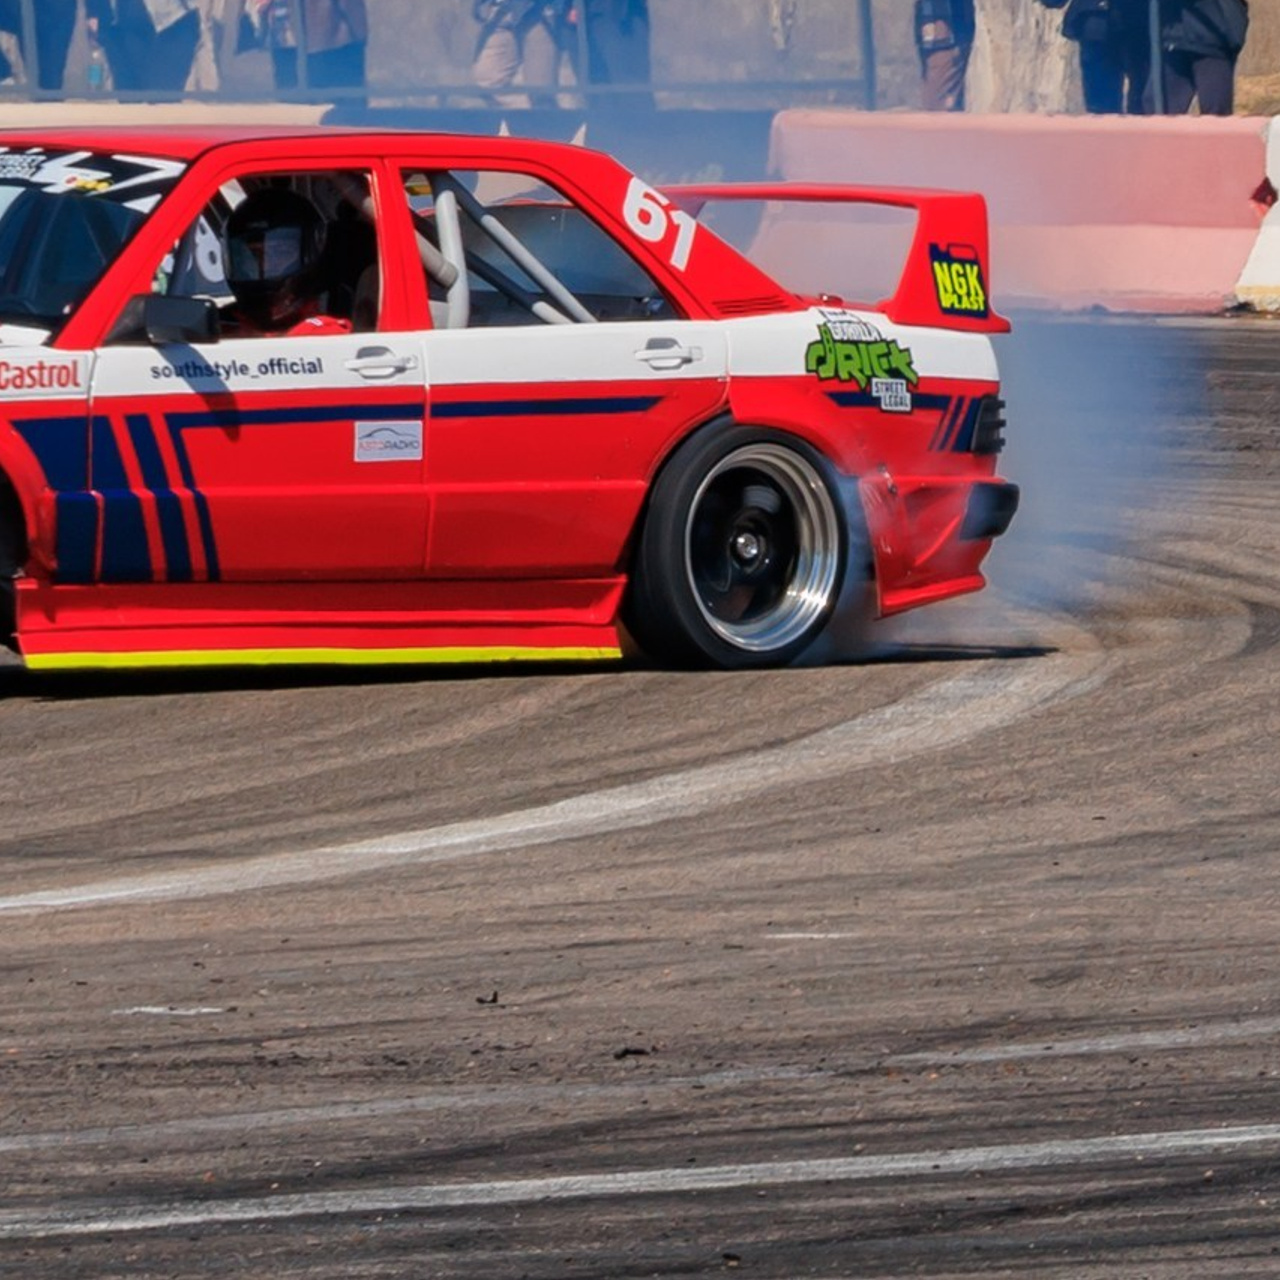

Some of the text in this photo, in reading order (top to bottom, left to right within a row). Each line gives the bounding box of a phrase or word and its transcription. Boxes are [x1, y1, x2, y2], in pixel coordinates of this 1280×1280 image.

[623, 176, 696, 272] 61
[933, 261, 984, 300] NGK
[150, 357, 324, 382] southstyle_official
[873, 381, 905, 394] STREET
[883, 394, 910, 408] LEGAL
